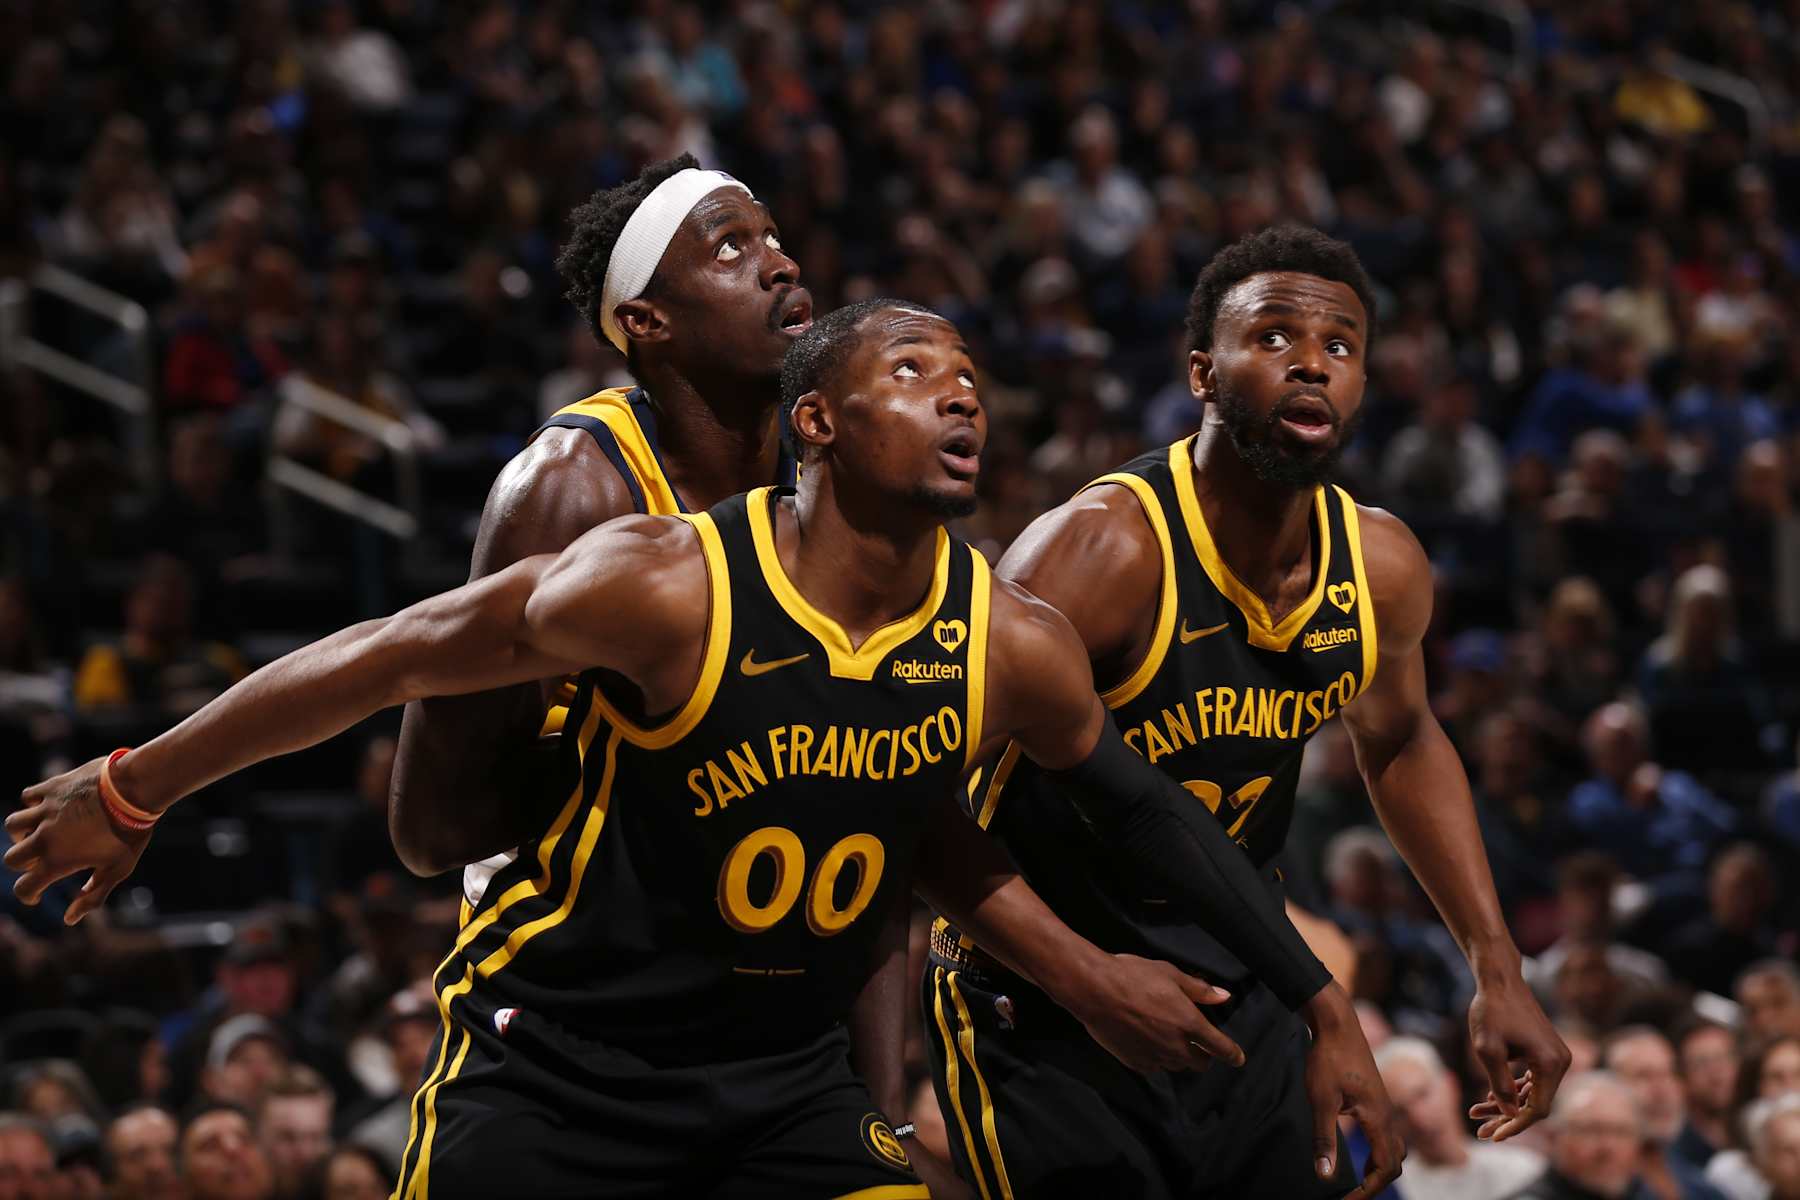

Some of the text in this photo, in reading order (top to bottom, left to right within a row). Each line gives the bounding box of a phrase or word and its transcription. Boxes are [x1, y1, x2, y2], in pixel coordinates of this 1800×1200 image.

[939, 627, 959, 643] DM
[1303, 627, 1358, 649] Rakuten
[892, 659, 962, 680] Rakuten
[1195, 671, 1356, 739] FRANCISCO
[687, 706, 961, 817] SAN FRANCISCO
[717, 826, 885, 936] 00
